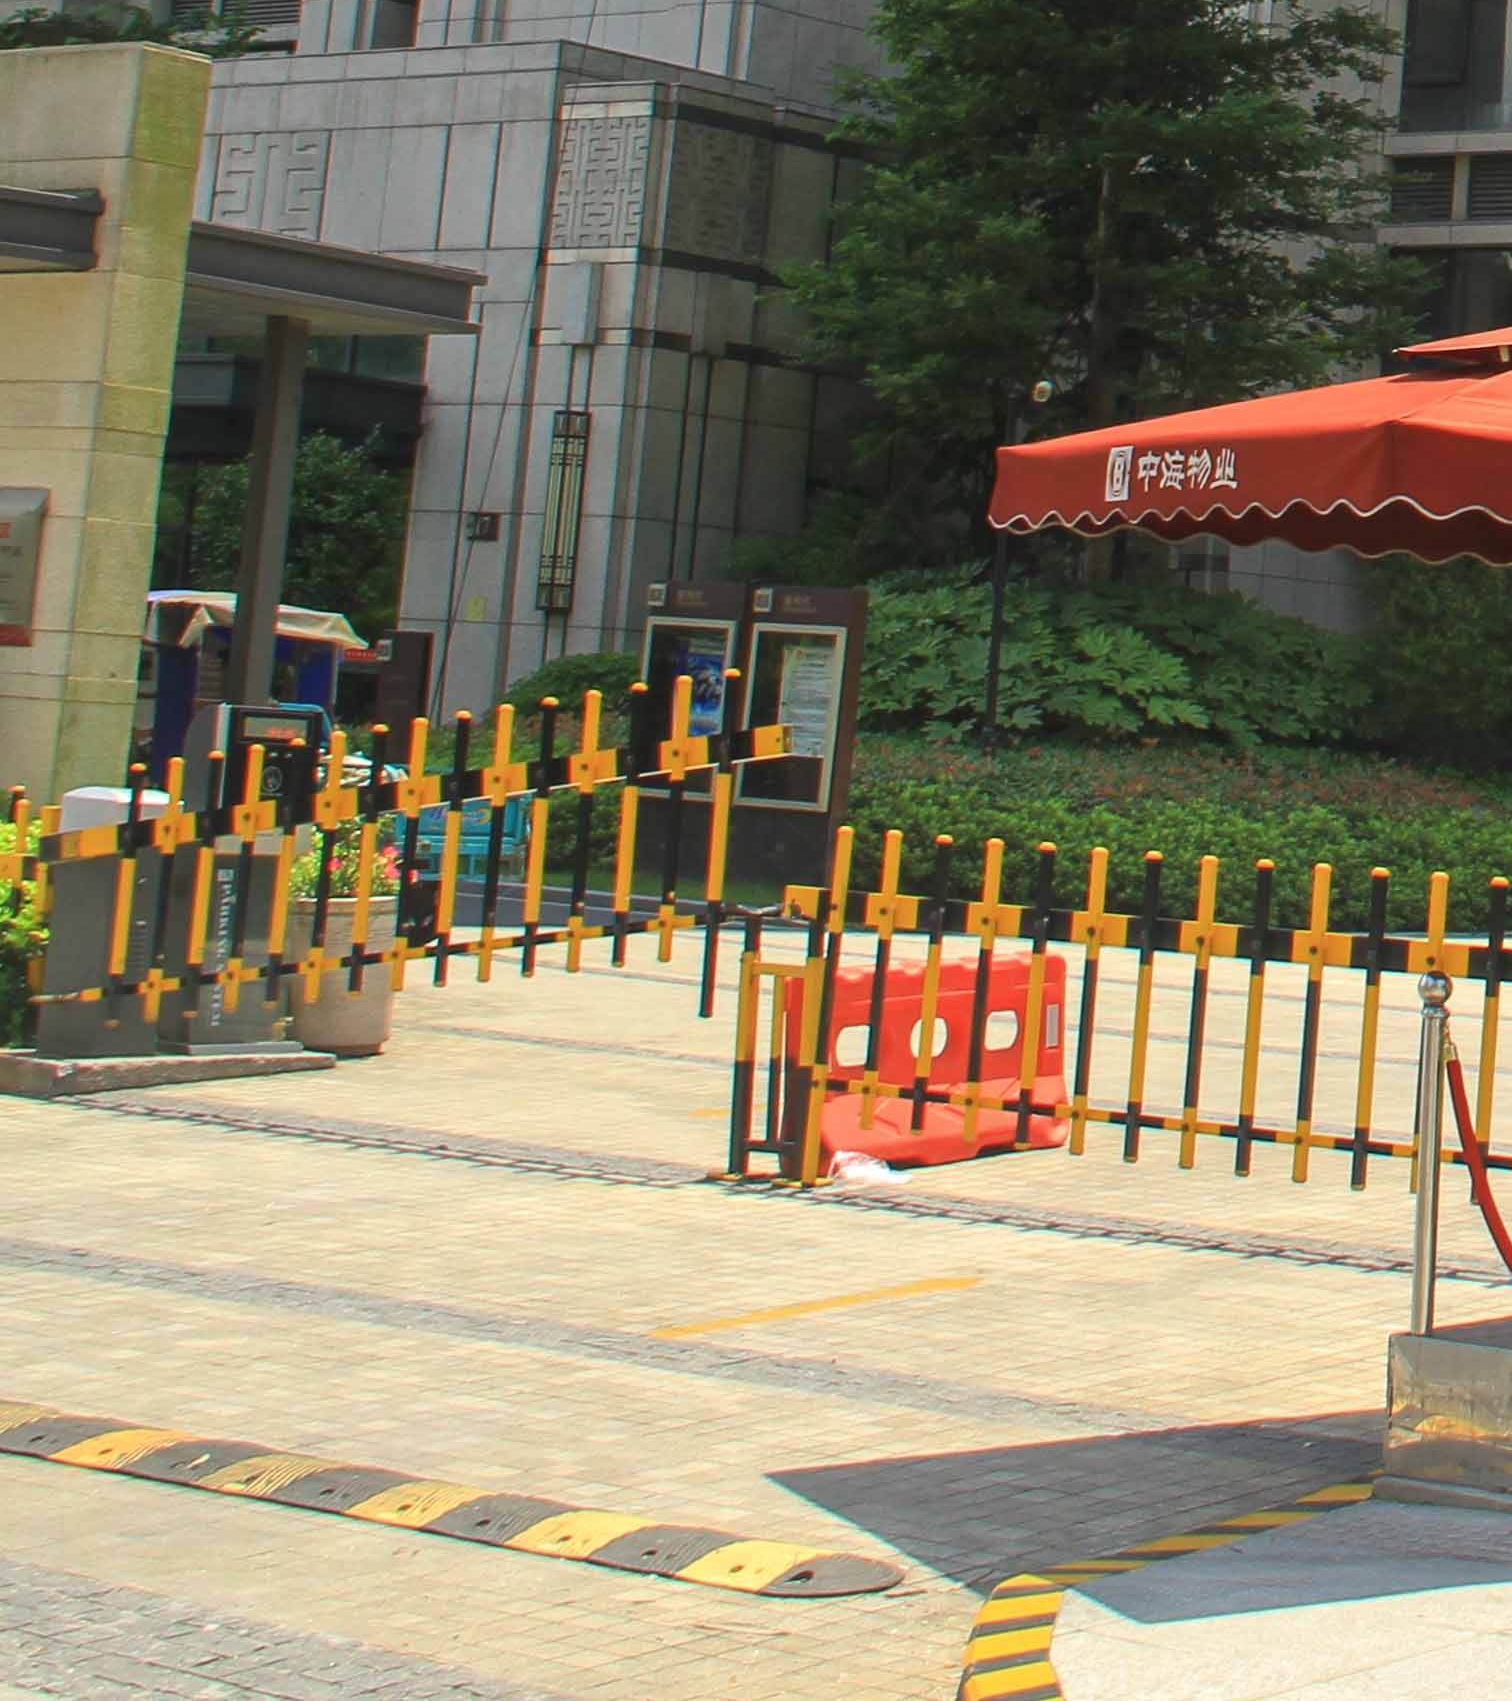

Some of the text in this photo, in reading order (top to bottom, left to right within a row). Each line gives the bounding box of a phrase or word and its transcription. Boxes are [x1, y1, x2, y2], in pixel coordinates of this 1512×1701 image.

[1137, 448, 1238, 492] 中海物业
[210, 962, 226, 1027] SSTEM
